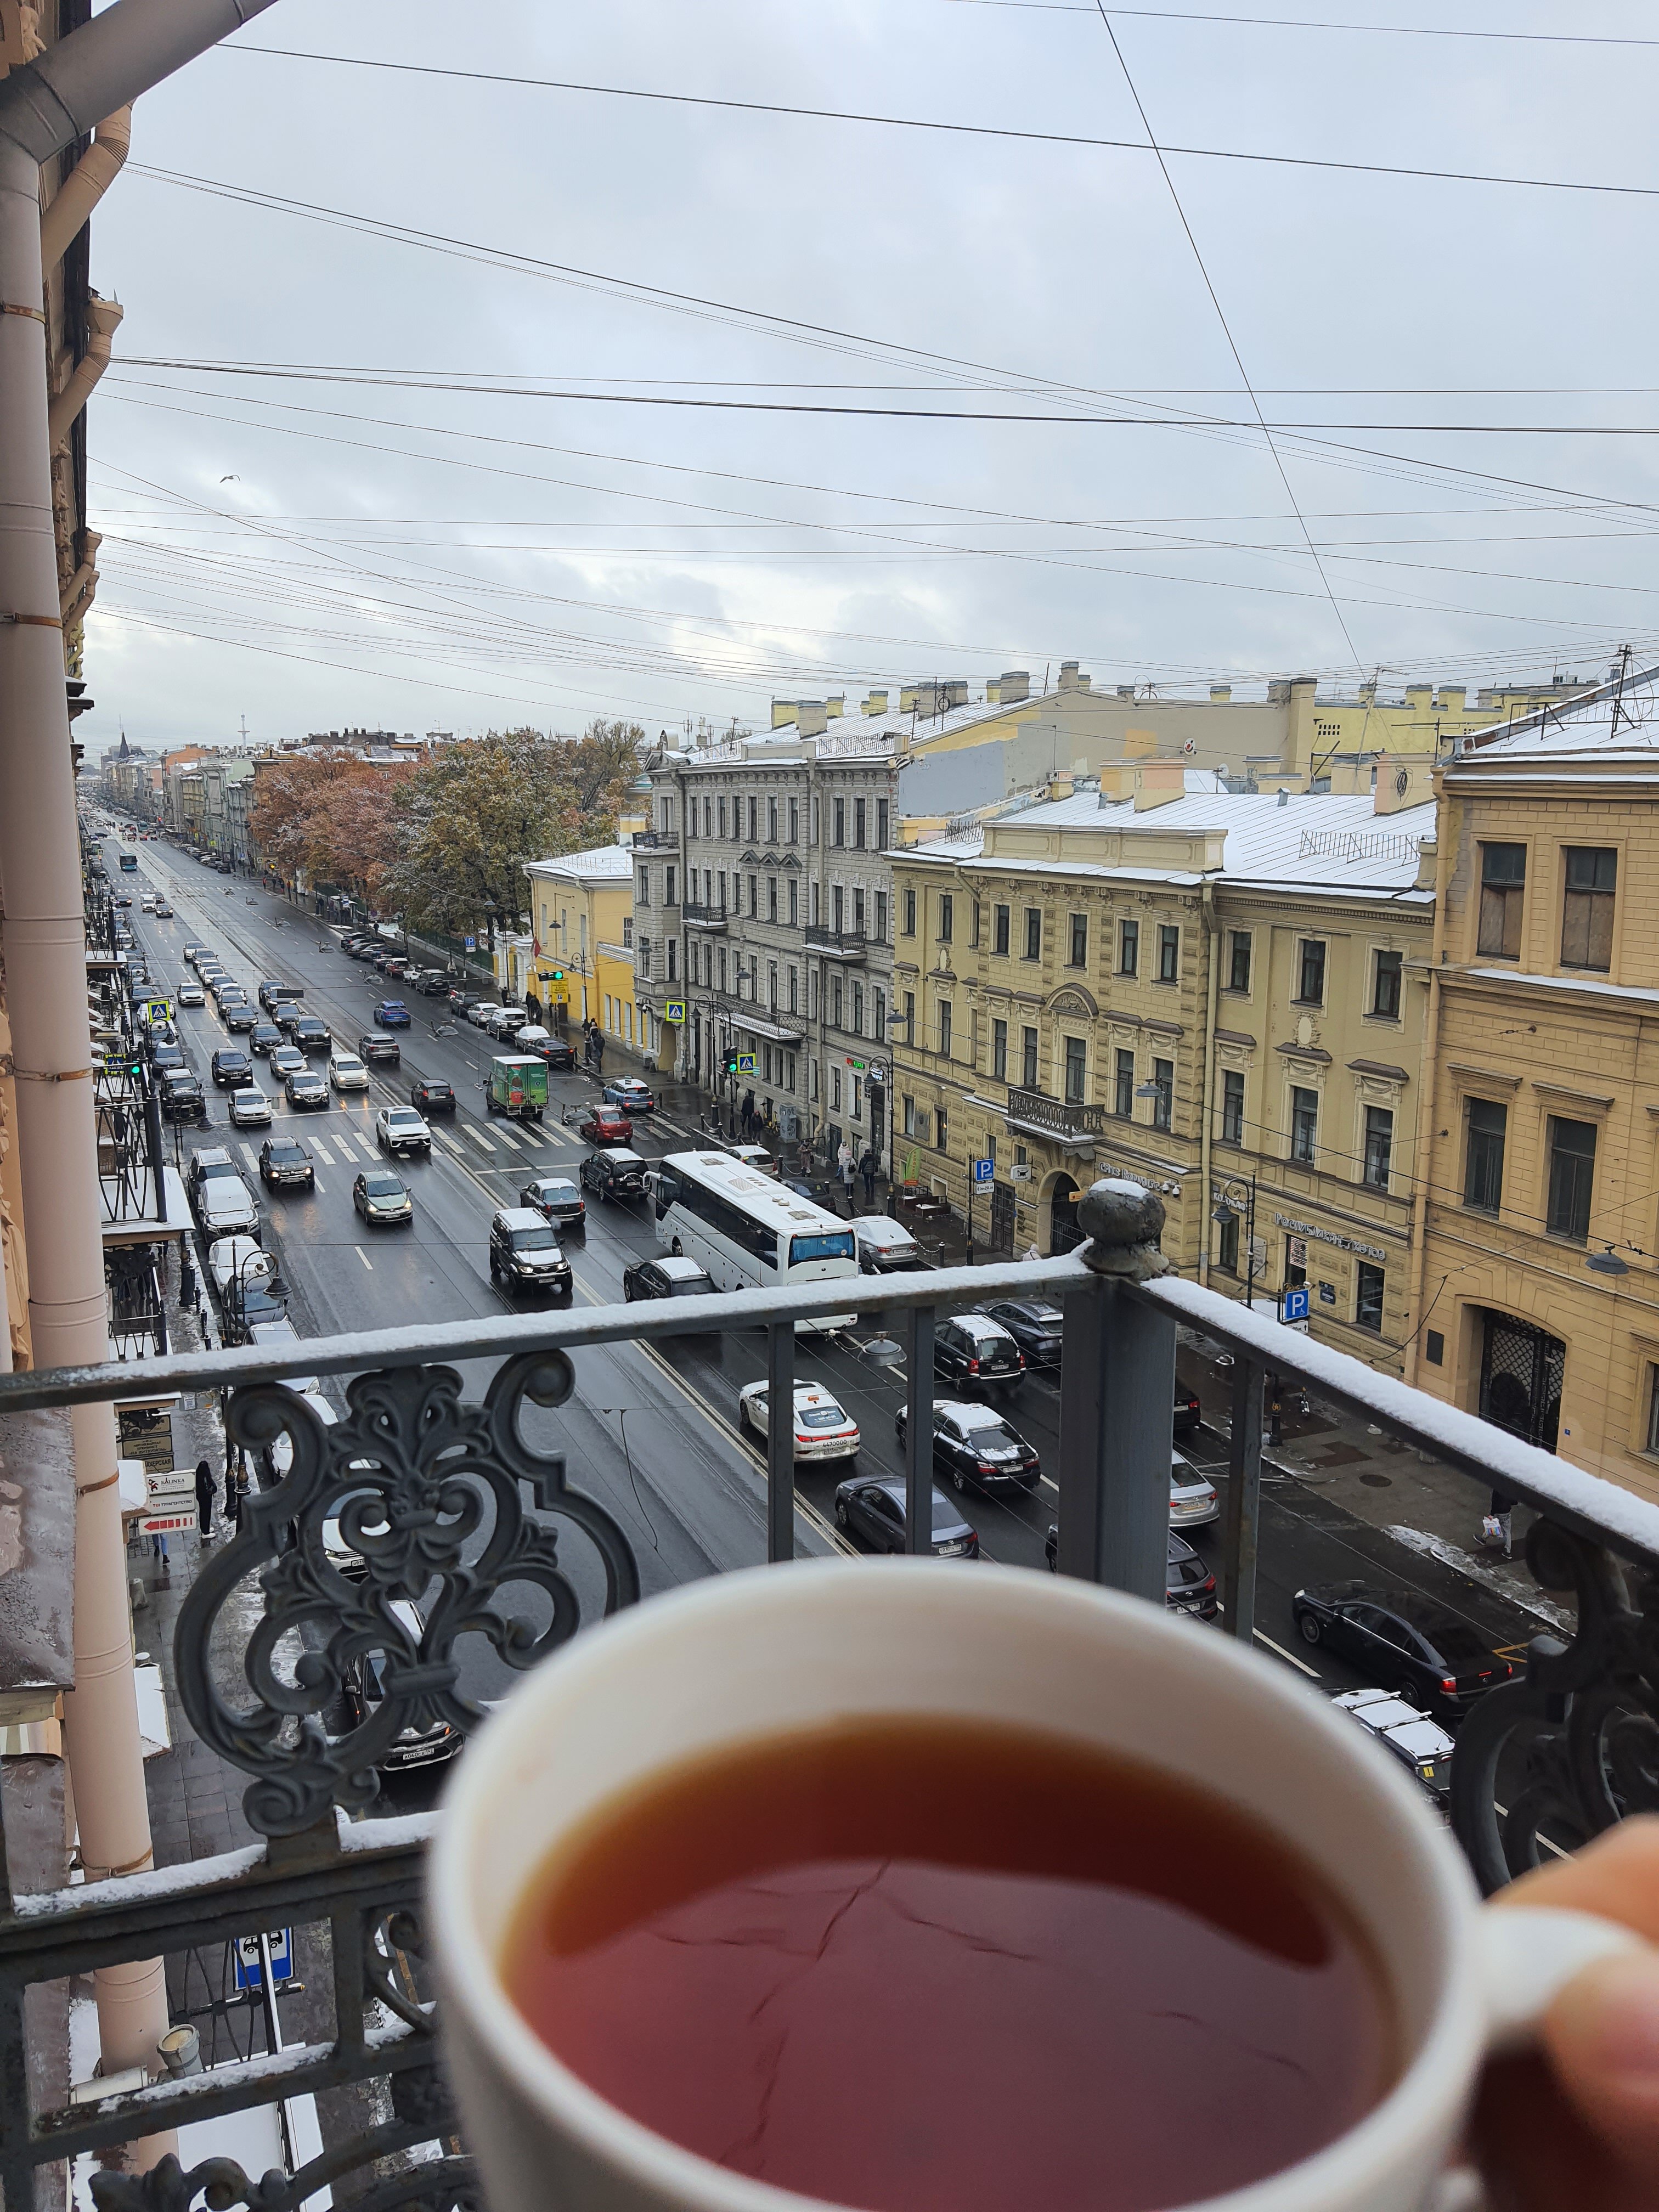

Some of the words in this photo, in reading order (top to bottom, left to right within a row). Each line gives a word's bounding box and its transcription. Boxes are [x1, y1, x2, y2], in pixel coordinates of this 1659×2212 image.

[468, 937, 474, 945] P
[981, 1161, 991, 1178] P
[1292, 1293, 1305, 1316] P
[822, 1439, 847, 1447] 4470000
